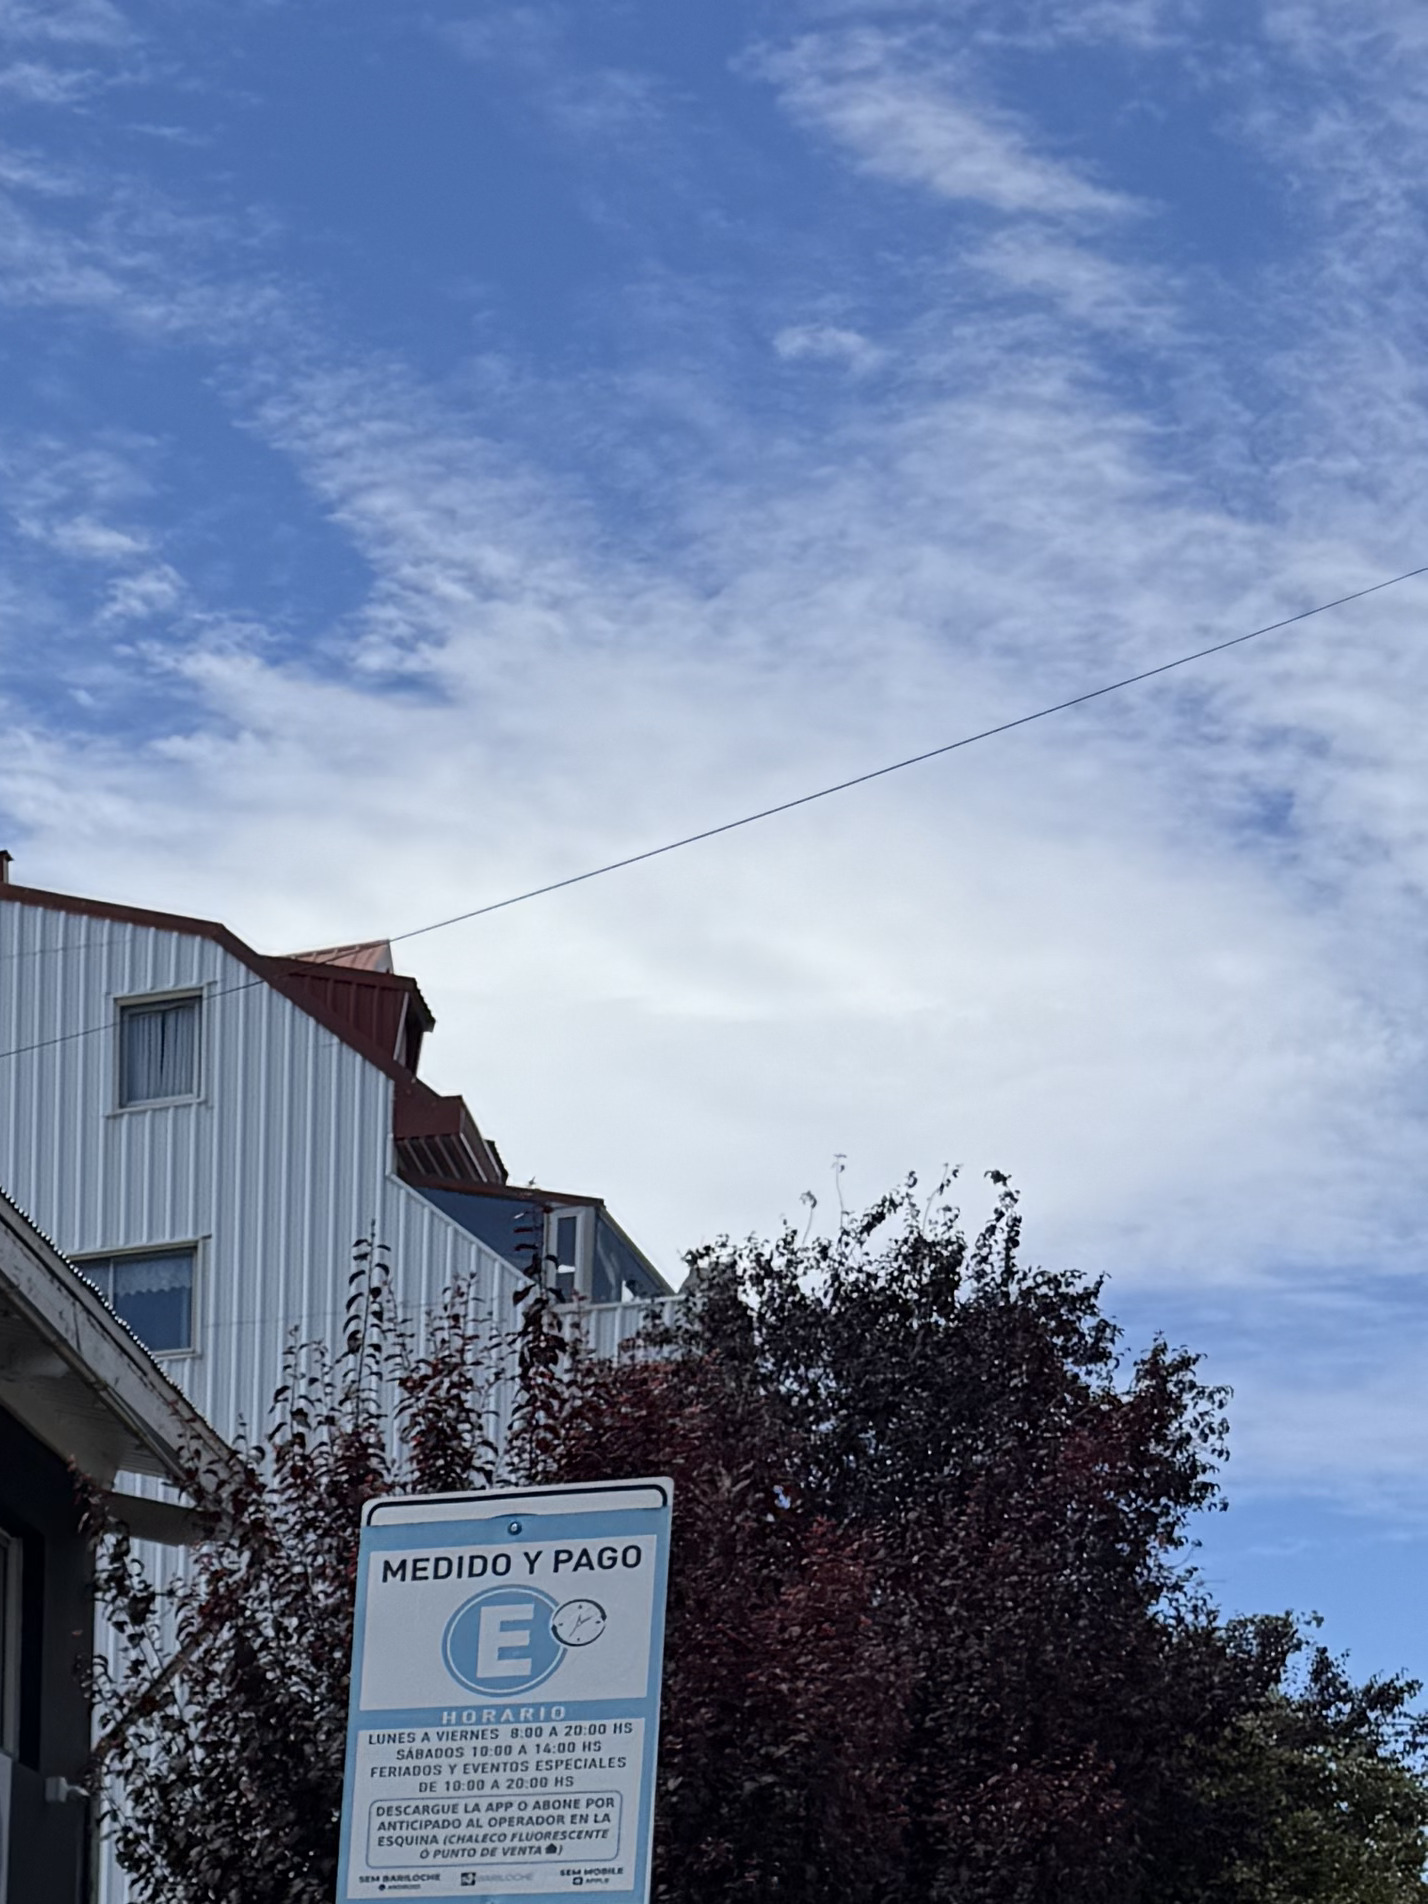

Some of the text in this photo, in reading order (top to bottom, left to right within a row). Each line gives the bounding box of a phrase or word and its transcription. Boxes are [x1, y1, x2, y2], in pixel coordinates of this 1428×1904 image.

[381, 1545, 642, 1583] MEDIDO Y PAGO
[476, 1603, 535, 1678] E
[442, 1706, 566, 1725] HORARIO
[368, 1722, 634, 1745] LUNES A VIERNES 8:00 A 20:00 HS
[396, 1740, 602, 1760] SÁBADOS 10:00 A 14:00 HS
[370, 1756, 627, 1778] FERIADOS Y EVENTOS ESPECIALES
[418, 1775, 574, 1793] DE 10:00 A 20:00 HS
[376, 1797, 615, 1817] DESCARGUE LA APP O ABONE POR
[377, 1812, 611, 1832] ANTICIPADO AL OPERADOR EN LA
[377, 1828, 610, 1848] ESQUINA (CHALECO FLUORESCENTE
[433, 1846, 477, 1859] PUNTO
[480, 1845, 497, 1857] DE
[501, 1844, 542, 1857] VENTA
[359, 1875, 380, 1883] SEM
[560, 1868, 581, 1877] SEM
